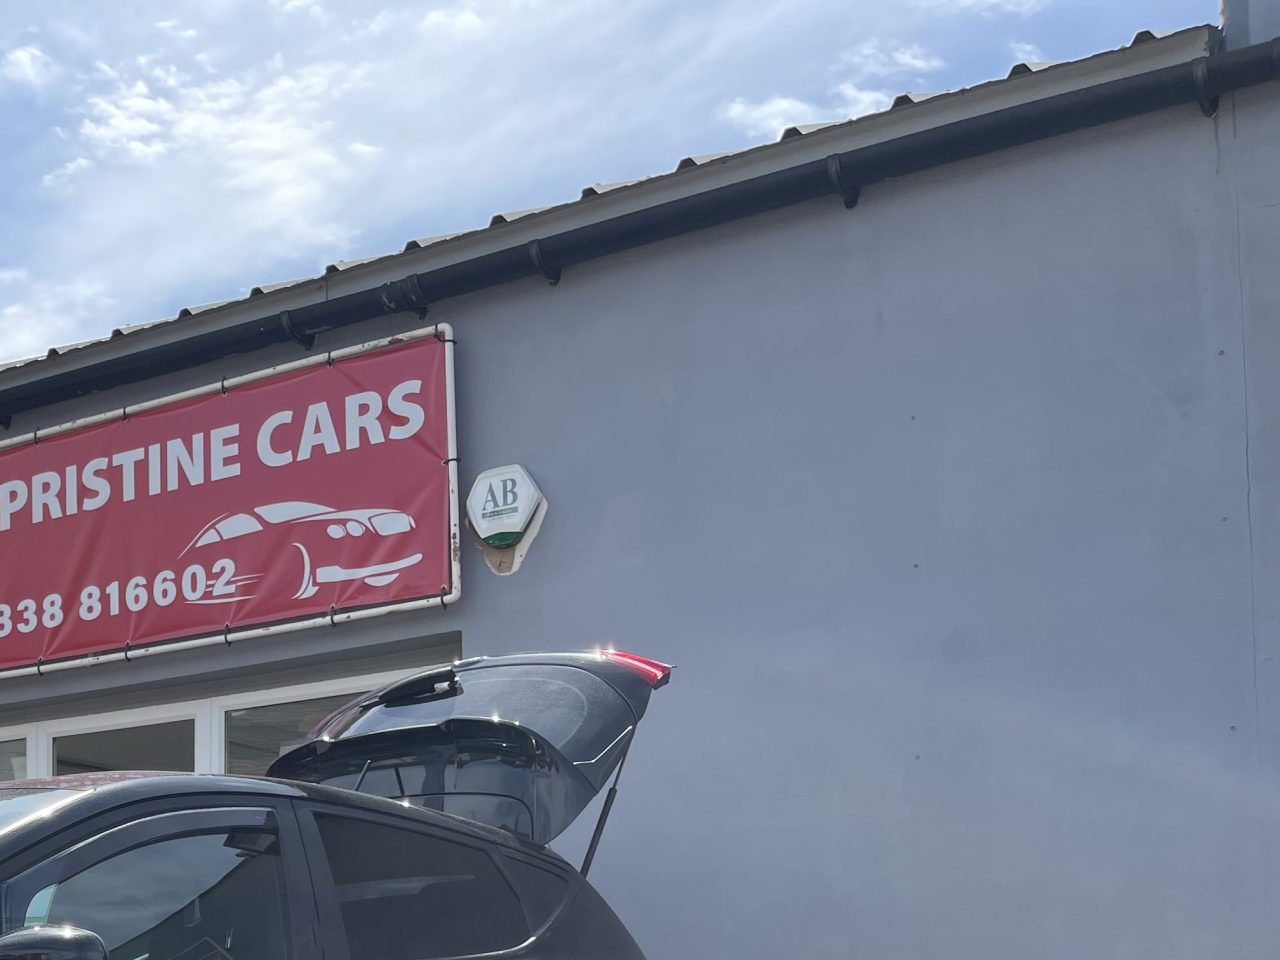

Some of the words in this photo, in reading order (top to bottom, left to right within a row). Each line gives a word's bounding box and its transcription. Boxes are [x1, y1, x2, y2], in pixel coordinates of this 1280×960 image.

[0, 423, 241, 532] PRISTINE
[256, 379, 425, 467] CARS
[482, 478, 518, 511] AB
[78, 558, 237, 621] 816602
